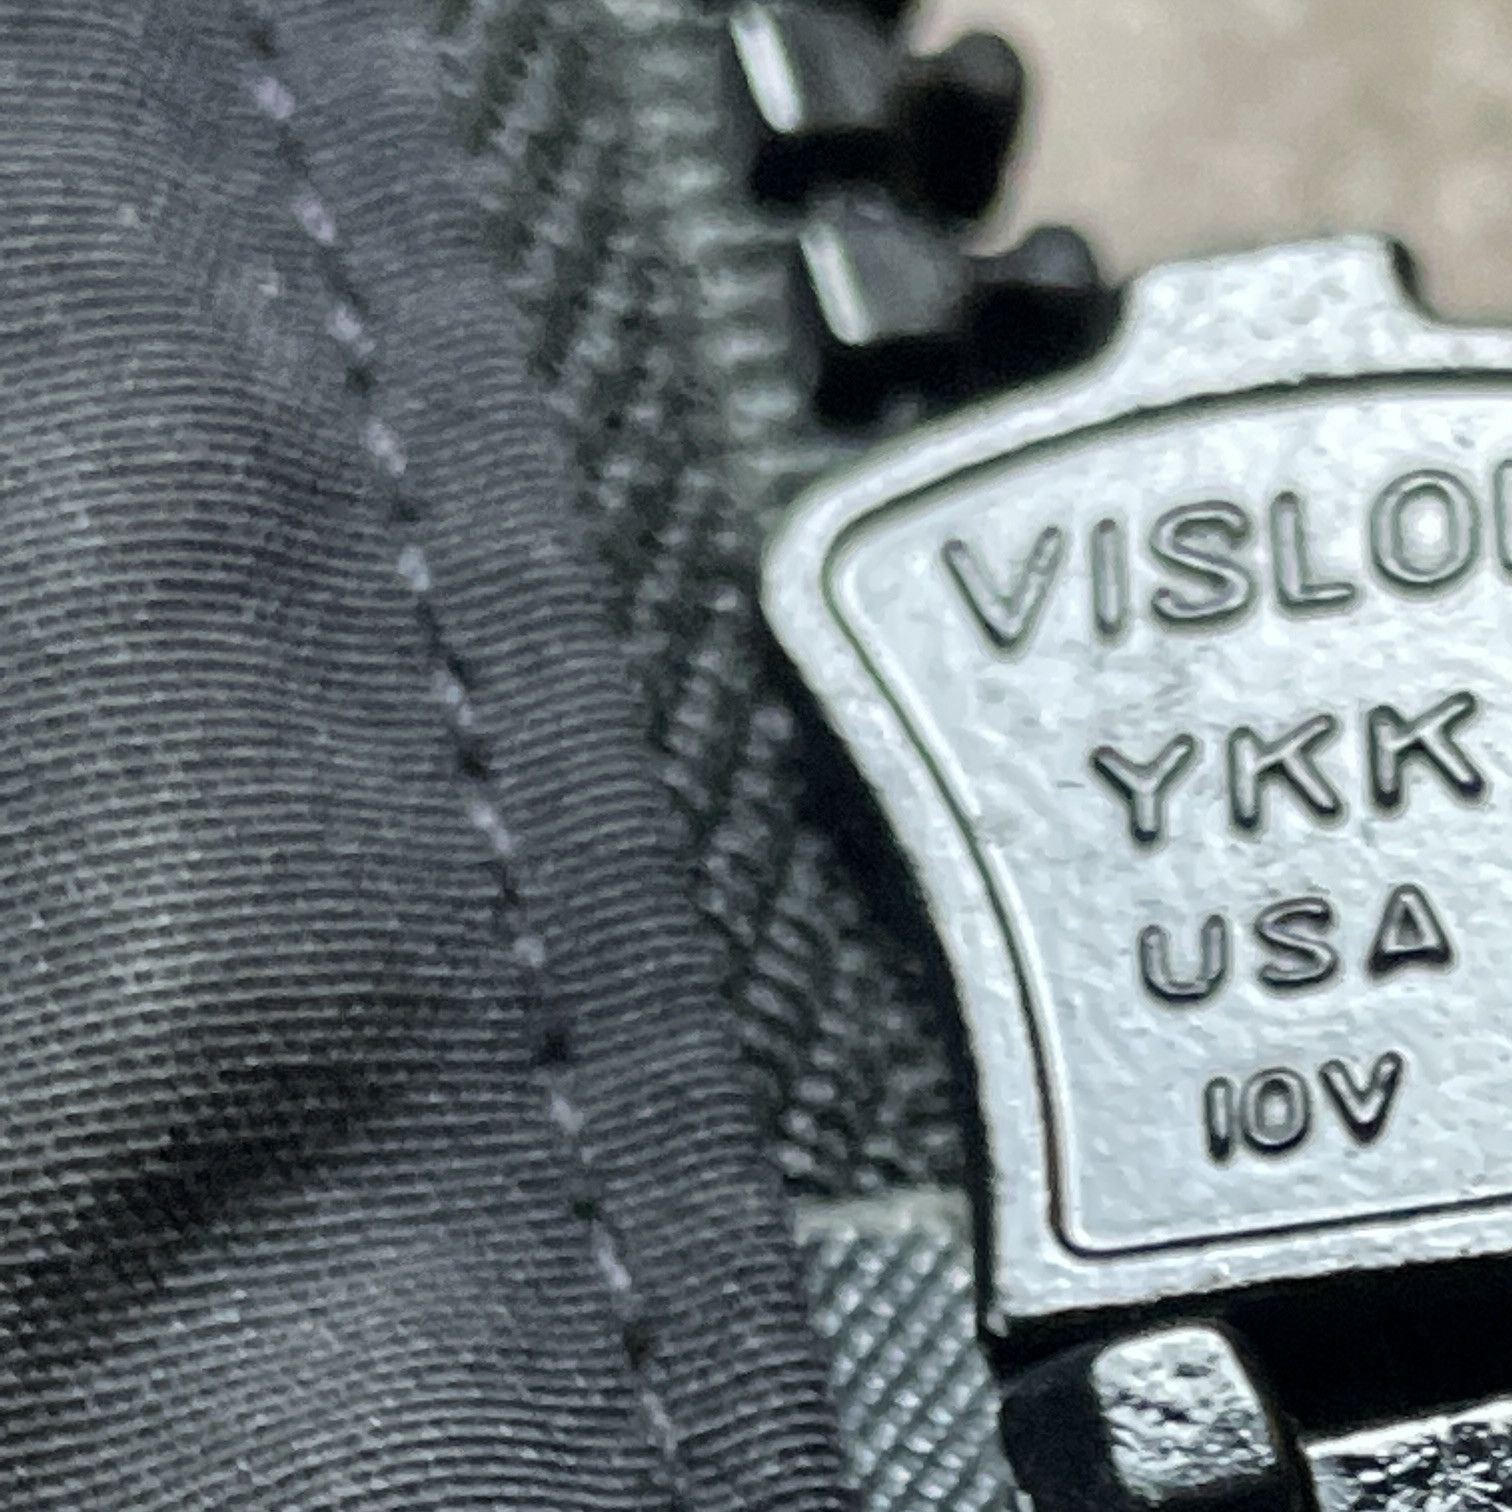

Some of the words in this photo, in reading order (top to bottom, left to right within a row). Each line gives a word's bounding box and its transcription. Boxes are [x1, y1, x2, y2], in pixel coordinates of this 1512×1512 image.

[1090, 690, 1487, 846] YKK
[1139, 883, 1454, 1003] USA
[1203, 1051, 1404, 1162] 10V
